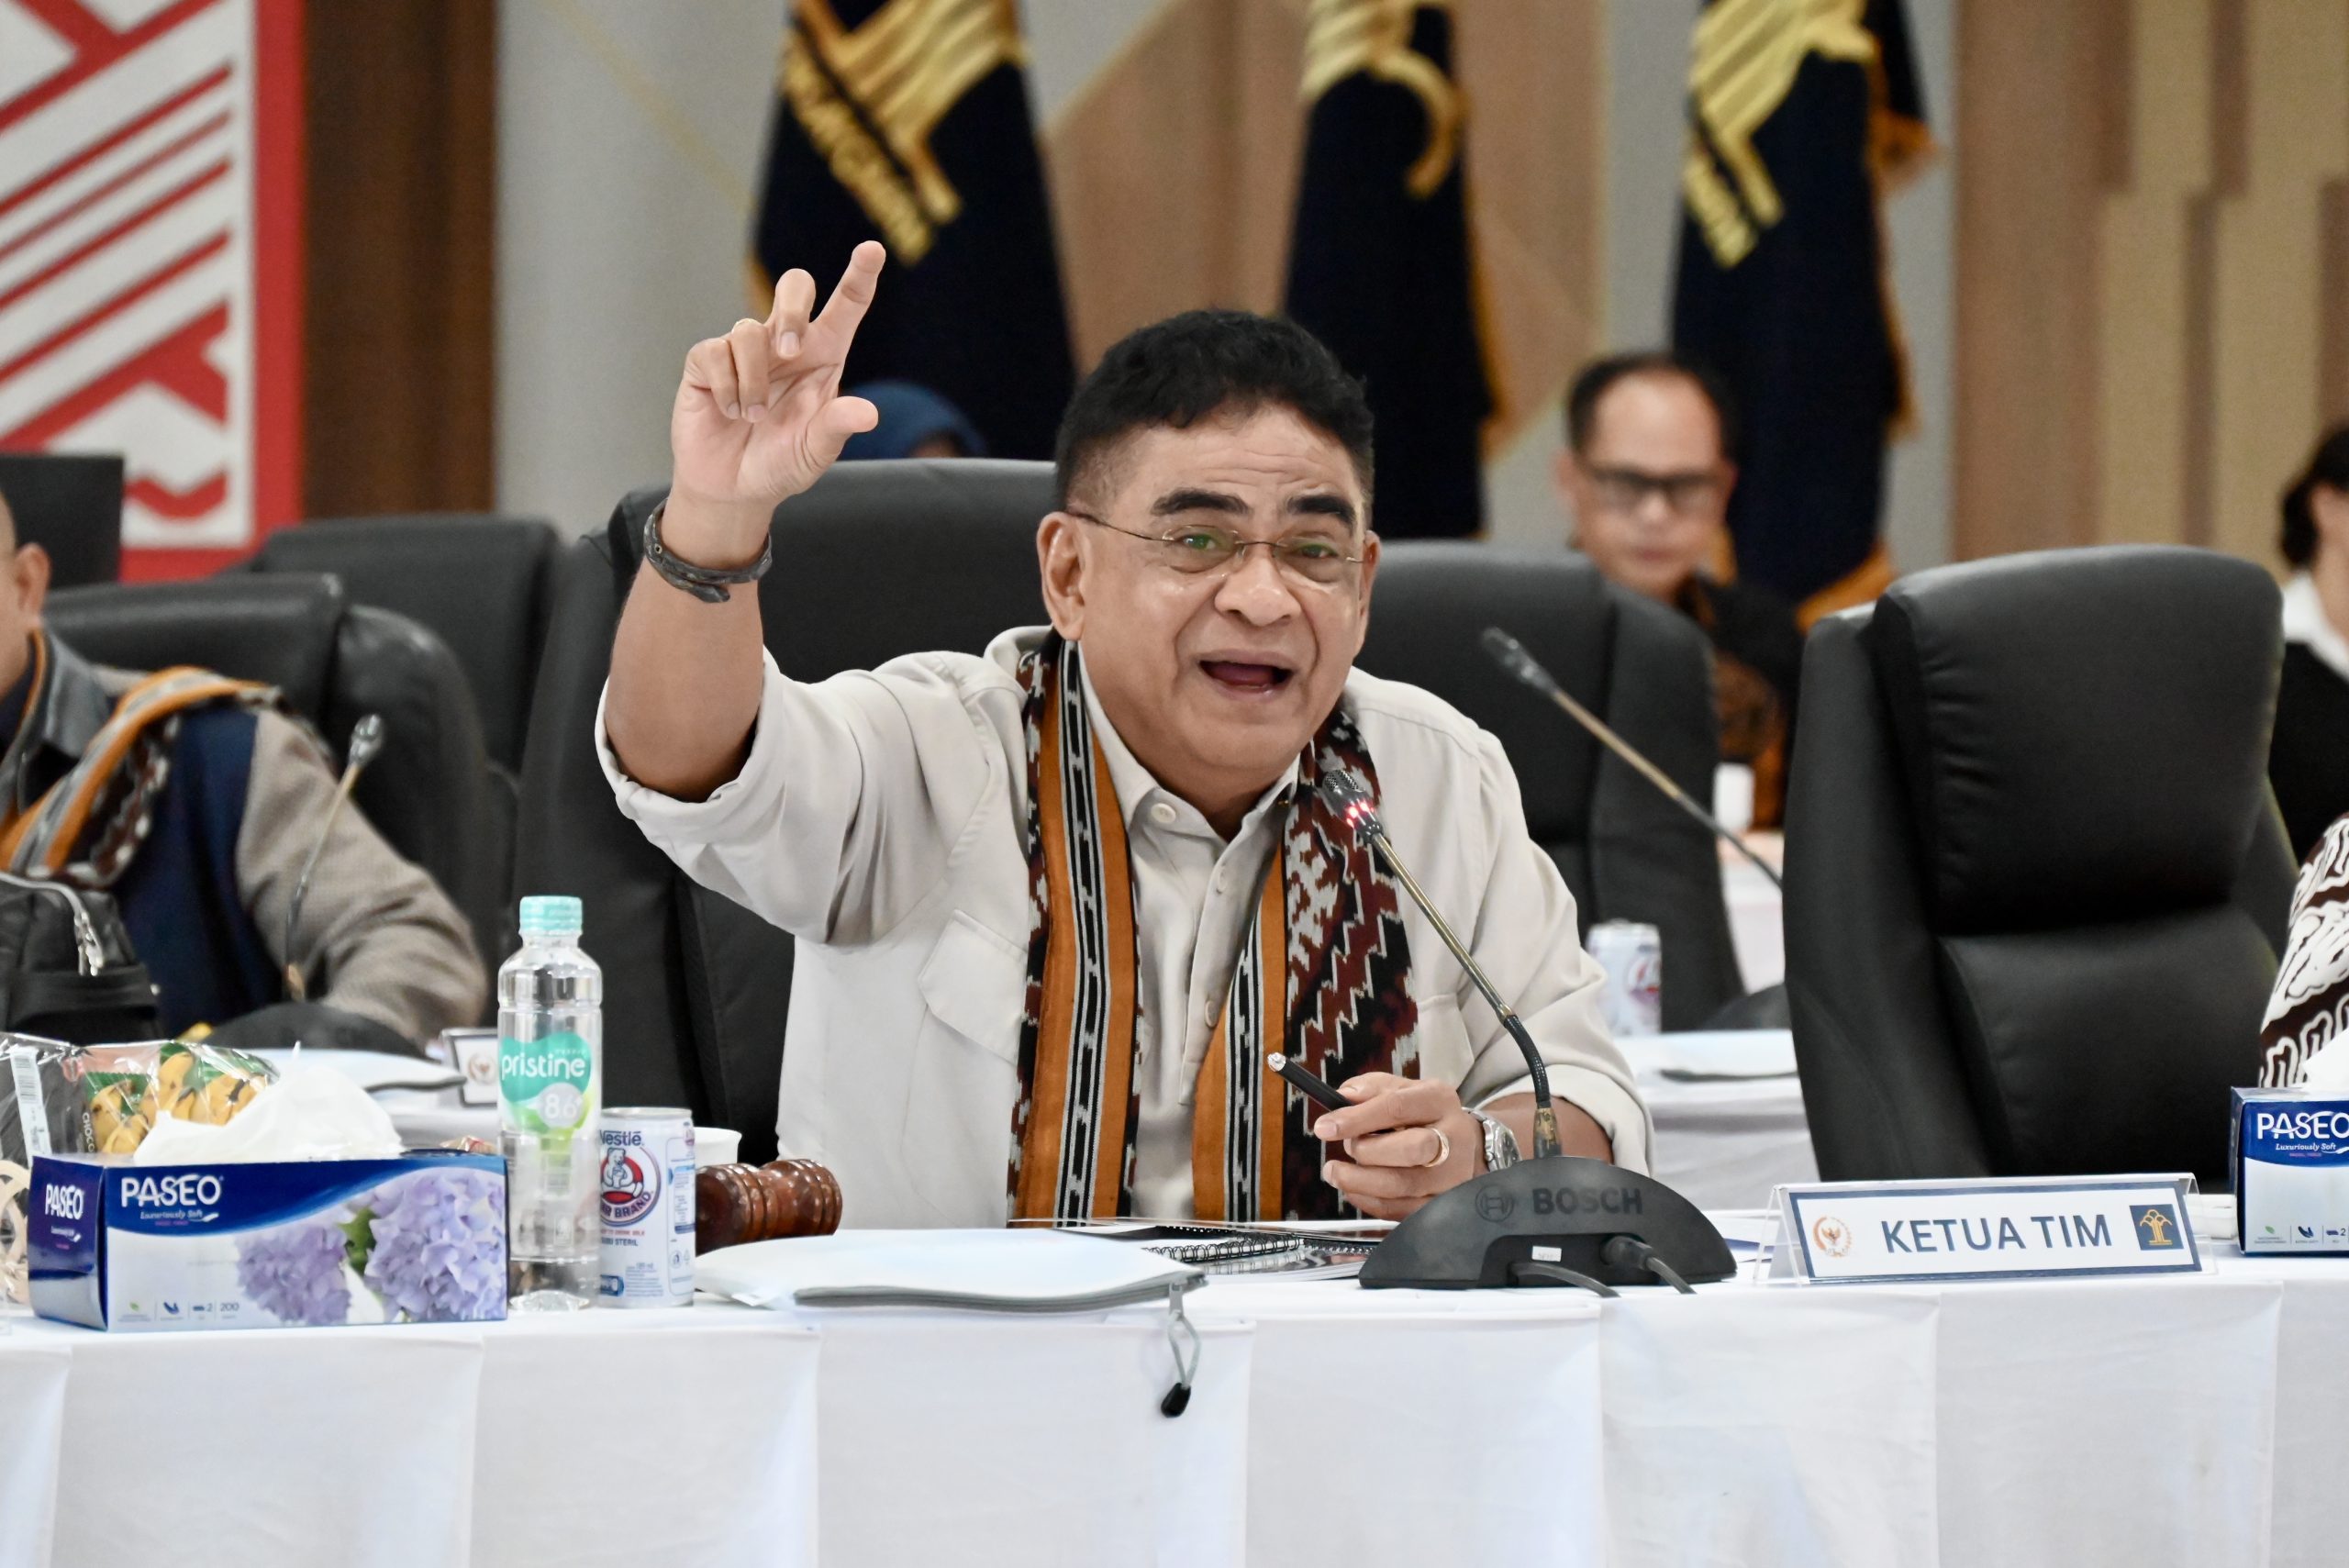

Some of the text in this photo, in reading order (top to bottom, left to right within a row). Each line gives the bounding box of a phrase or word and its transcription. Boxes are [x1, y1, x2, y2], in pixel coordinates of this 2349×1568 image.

[502, 1052, 585, 1081] pristine
[2257, 1110, 2349, 1140] PASEO
[2276, 1142, 2336, 1151] Luxuriously Soft
[45, 1184, 83, 1220] PASEO
[121, 1174, 220, 1207] PASEO
[1532, 1187, 1642, 1215] BOSCH
[615, 1192, 651, 1218] BRAND
[1881, 1214, 2112, 1253] KETUA TIM
[2341, 1228, 2346, 1236] 2
[220, 1303, 239, 1312] 200
